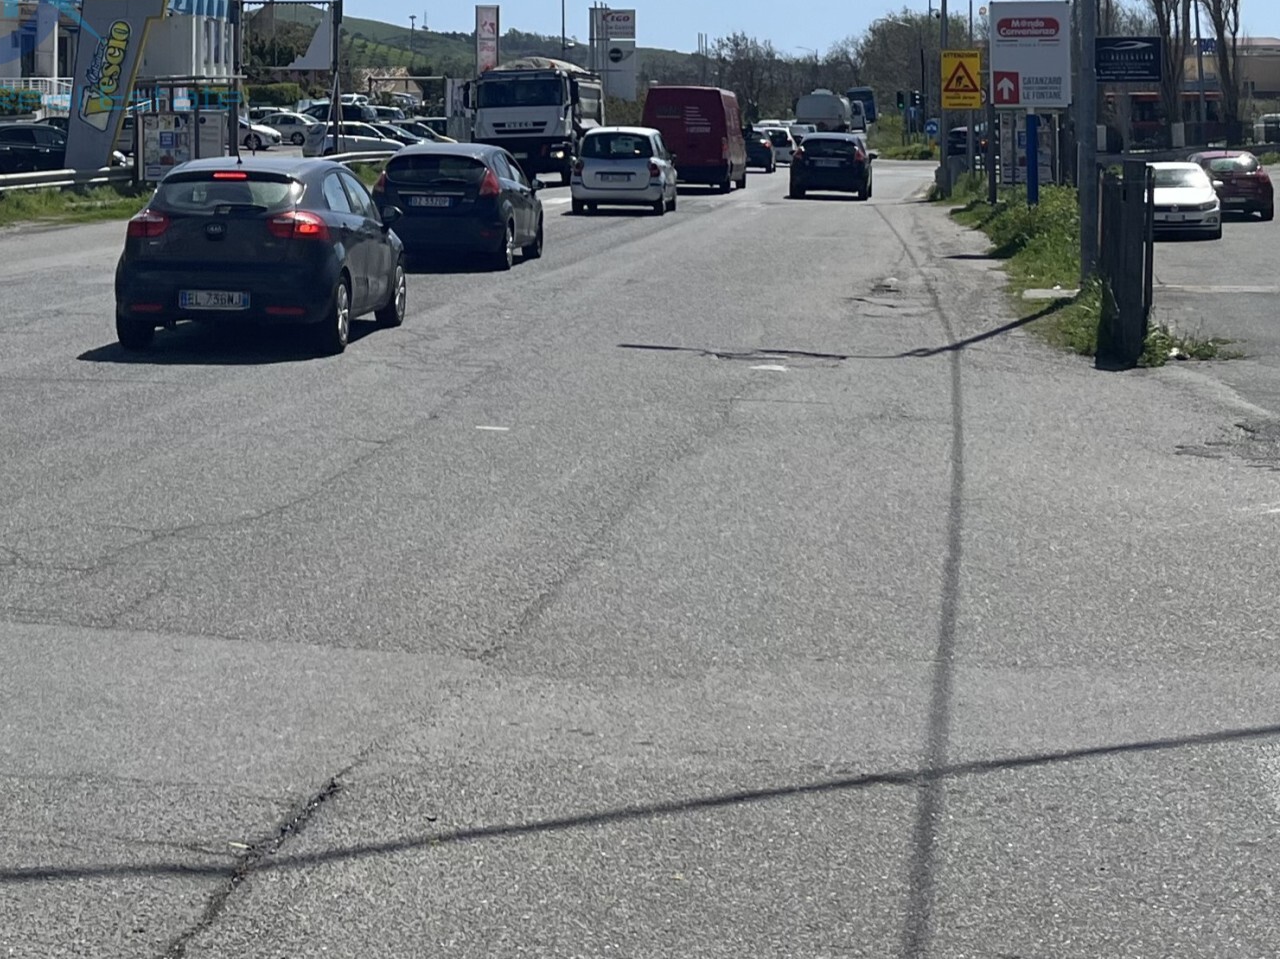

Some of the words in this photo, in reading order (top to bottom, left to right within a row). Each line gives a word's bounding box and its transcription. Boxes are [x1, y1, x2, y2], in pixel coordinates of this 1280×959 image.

[1000, 27, 1056, 36] Convenienza
[81, 20, 131, 126] Vescio
[1022, 76, 1062, 85] CATANZARO
[1022, 91, 1032, 100] LE
[1034, 91, 1062, 100] FONTANE
